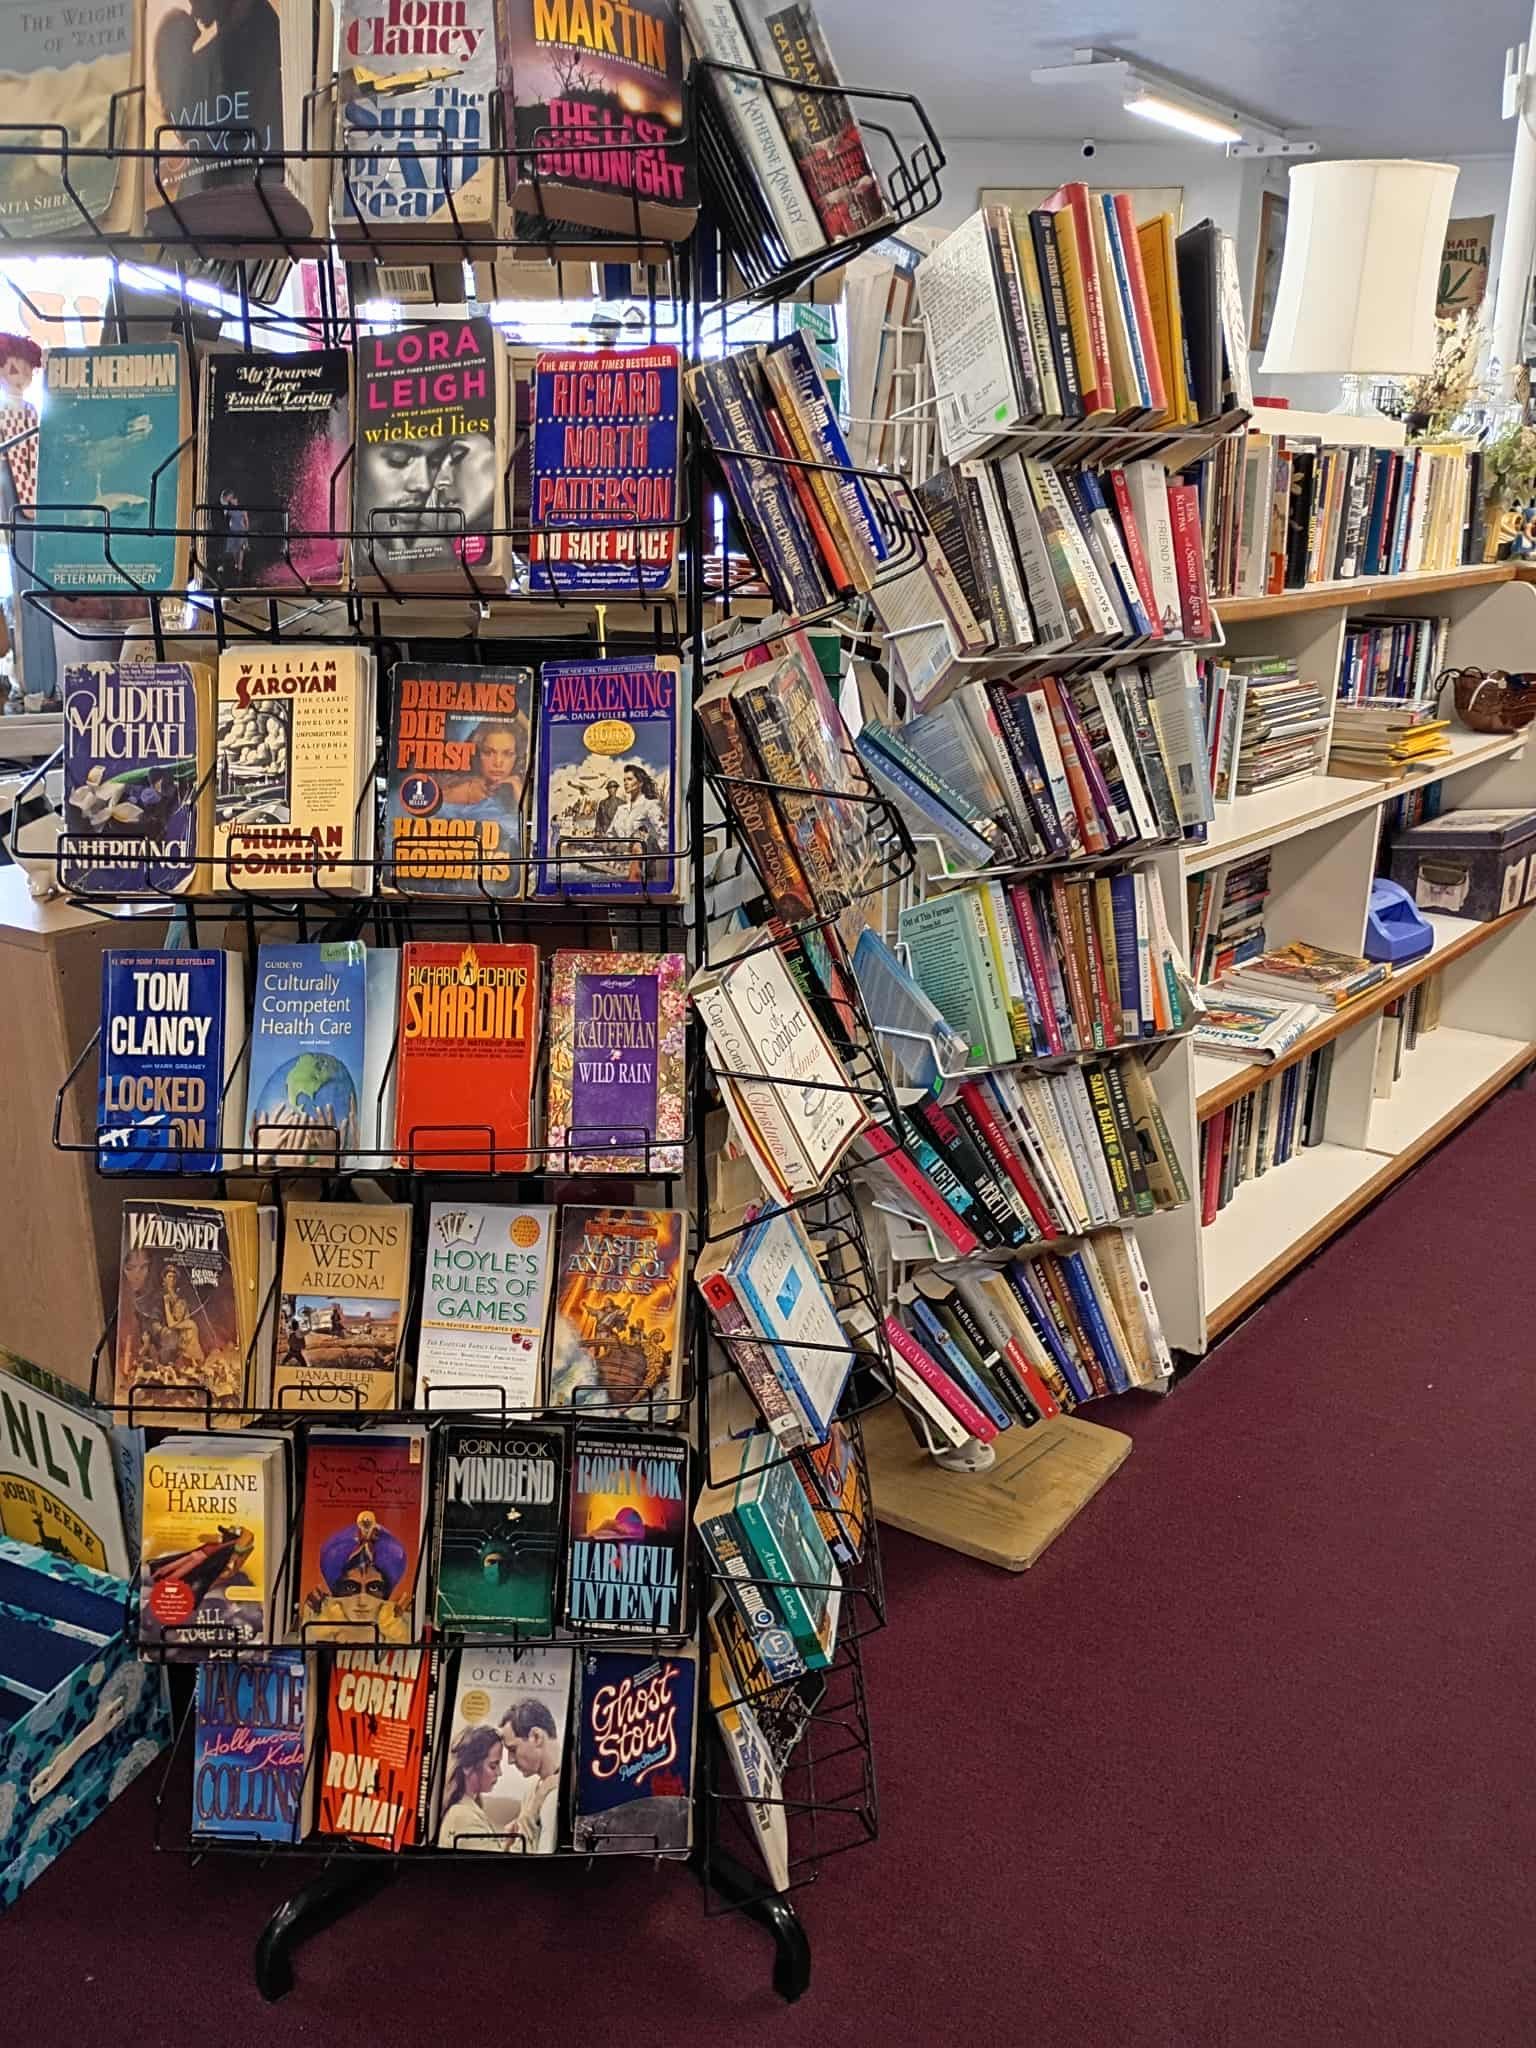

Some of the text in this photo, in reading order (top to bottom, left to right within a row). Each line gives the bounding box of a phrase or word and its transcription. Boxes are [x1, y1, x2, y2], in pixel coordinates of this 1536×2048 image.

[21, 3, 126, 32] THE WEIGHT
[44, 29, 126, 53] OF WATER
[347, 18, 485, 61] Clancy
[534, 0, 667, 71] MARTIN
[170, 91, 250, 129] WILDE
[535, 134, 685, 200] GOODNIGHT
[738, 95, 811, 228] KATHERINE KINGSLEY
[1043, 243, 1061, 287] MUSTANG
[1058, 332, 1070, 353] MAX
[1006, 279, 1024, 330] OUTLAW
[1017, 335, 1034, 379] TAMER
[374, 325, 480, 368] LORA
[236, 366, 323, 383] My Dearest
[542, 355, 672, 372] THE NEW YORK TIMES BESTSELLER
[225, 392, 333, 406] Emilie Loring
[262, 379, 301, 391] Love
[369, 370, 486, 410] LEIGH
[553, 371, 661, 416] RICHARD
[365, 414, 489, 444] wicked lies
[564, 426, 648, 468] NORTH
[539, 477, 671, 521] PATTERSON
[722, 394, 808, 577] JULIE PRINCE CHARMING
[1171, 493, 1190, 533] KLEYPAS
[1184, 501, 1196, 522] LISA
[537, 529, 668, 560] NO SAFE PLACE
[1155, 518, 1172, 584] FRIEND ME
[54, 573, 86, 585] PETER
[990, 584, 1002, 605] TOM
[240, 661, 337, 675] WILLIAM
[96, 672, 186, 724] JUDITH
[235, 675, 337, 710] SAROYAN
[401, 679, 516, 713] DREAMS
[548, 671, 672, 713] AWAKENING
[399, 709, 446, 740] DIE
[571, 709, 650, 721] DANA FULLER ROSS
[69, 706, 194, 759] MICHAEL
[397, 739, 475, 771] FIRST
[1043, 801, 1058, 827] ARON
[240, 826, 343, 850] HUMAN
[901, 905, 955, 929] Out of This Furnace
[264, 961, 302, 969] GUIDE TO
[408, 967, 528, 987] RICHARD ADAMS
[133, 972, 190, 1012] TOM
[264, 974, 340, 996] Culturally
[704, 994, 713, 1005] A
[747, 980, 777, 1016] Cup
[262, 994, 351, 1017] Competent
[406, 984, 526, 1040] SHARDIK
[591, 994, 642, 1022] DONNA
[707, 1002, 725, 1035] Cup
[111, 1016, 212, 1056] CLANCY
[260, 1017, 352, 1037] Health Care
[577, 1021, 656, 1050] KAUFFMAN
[760, 1010, 807, 1067] Comfort
[768, 1014, 785, 1031] of
[1093, 1026, 1104, 1047] USED
[578, 1062, 652, 1084] WILD RAIN
[106, 1075, 205, 1113] LOCKED
[1088, 1072, 1118, 1144] SAINT DEATH
[168, 1118, 206, 1149] ON
[1032, 1104, 1052, 1138] KARON
[963, 1114, 1007, 1179] BLACK HAND
[987, 1121, 1012, 1159] BICYCLING
[923, 1156, 962, 1198] LIGHT
[1114, 1158, 1127, 1188] MARCUS
[976, 1180, 1015, 1224] PERETTI
[128, 1212, 220, 1252] WINDSWEPT
[295, 1218, 398, 1247] WAGONS
[583, 1234, 658, 1260] MASTER
[310, 1243, 380, 1270] WEST
[433, 1250, 538, 1274] HOYLE'S
[569, 1254, 668, 1279] AND FOOL
[301, 1271, 385, 1291] ARIZONA!
[432, 1274, 538, 1298] RULES OF
[711, 1284, 726, 1300] R
[437, 1297, 527, 1323] GAMES
[883, 1321, 938, 1381] MEG CABOT
[295, 1369, 375, 1383] DANA FULLER
[299, 1380, 369, 1405] ROSS
[458, 1439, 549, 1456] ROBIN COOK
[149, 1464, 258, 1492] CHARLAINE
[448, 1456, 555, 1506] MINDBEND
[577, 1455, 682, 1500] ROBIN COOK
[1, 1481, 95, 1553] JOHN DEERE
[167, 1490, 238, 1515] HARRIS
[572, 1541, 678, 1586] HARMFUL
[570, 1580, 678, 1626] INTENT
[736, 1582, 769, 1617] COOK
[197, 1608, 225, 1625] ALL
[471, 1667, 557, 1686] OCEANS
[201, 1664, 304, 1729] JACKIE
[338, 1674, 414, 1720] COBEN
[592, 1664, 679, 1737] Ghost
[202, 1727, 304, 1761] Hollywood
[592, 1706, 677, 1785] Story
[327, 1751, 380, 1794] RUN
[196, 1762, 300, 1820] COLLINS
[336, 1794, 403, 1834] AWAY
